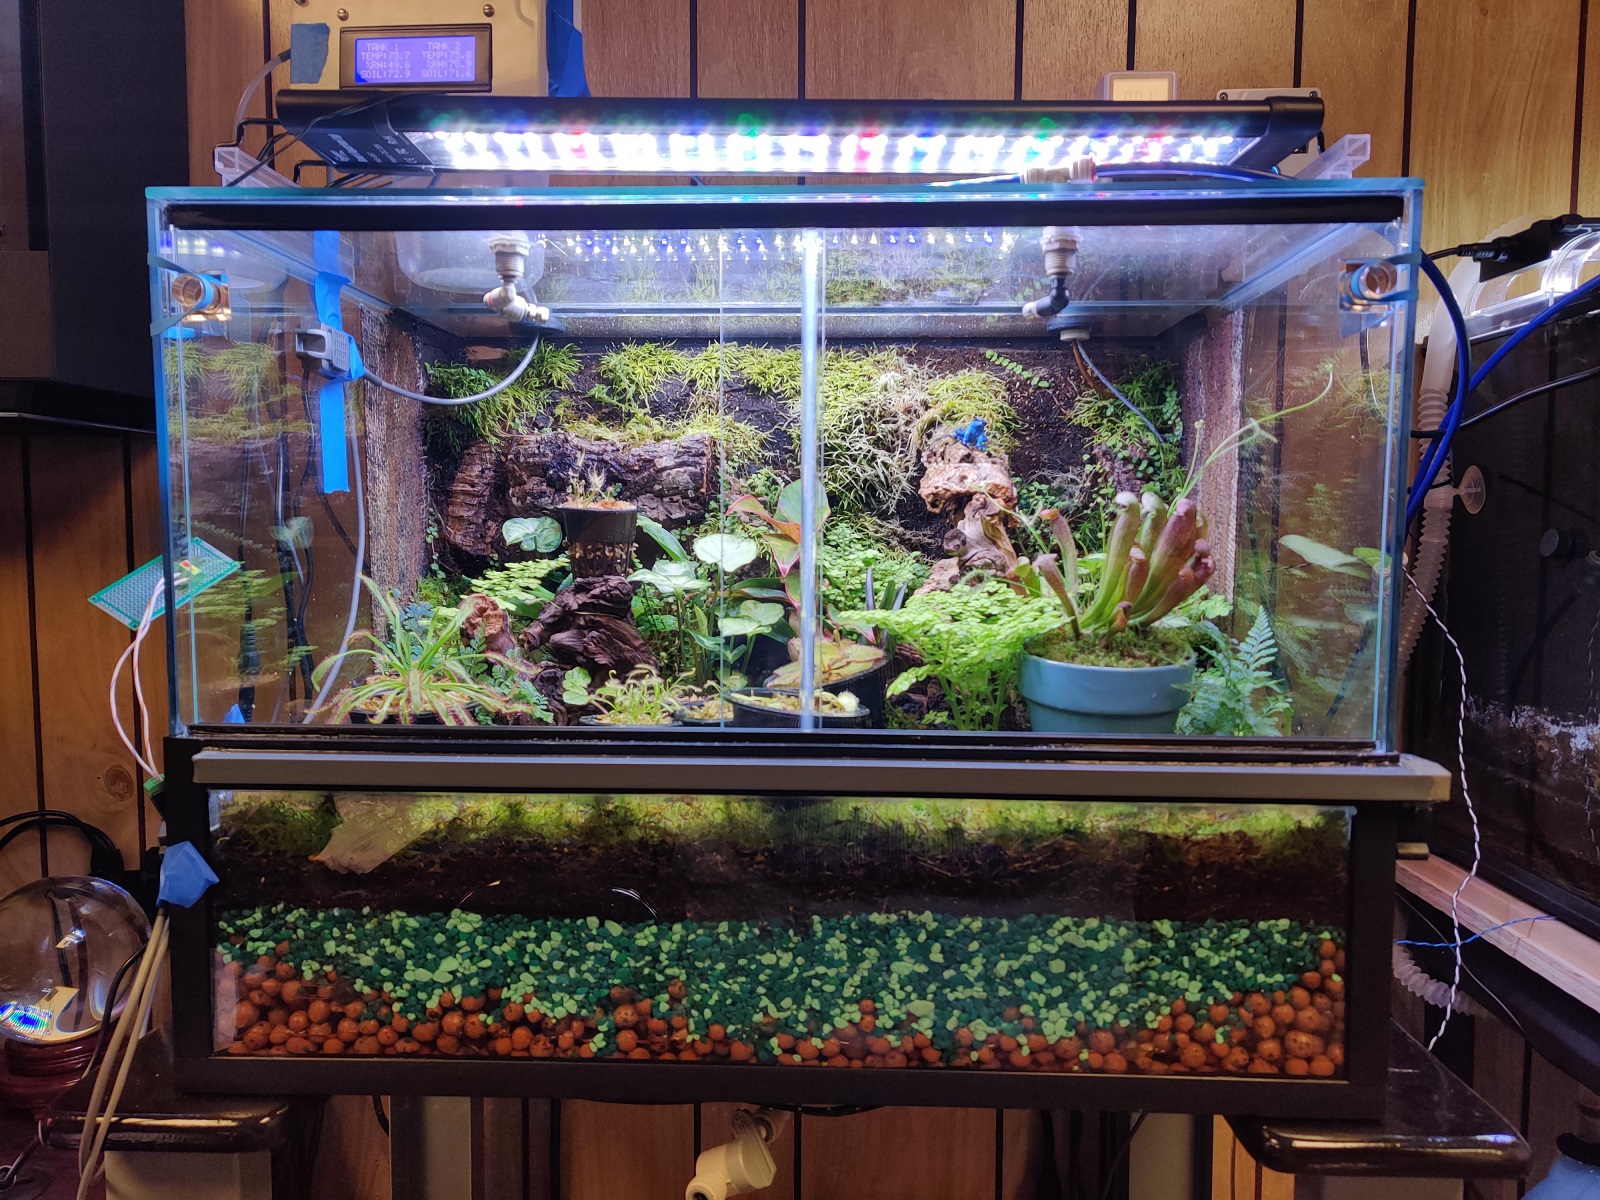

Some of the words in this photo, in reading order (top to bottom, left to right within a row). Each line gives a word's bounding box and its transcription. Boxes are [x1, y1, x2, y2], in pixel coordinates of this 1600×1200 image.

[366, 43, 388, 51] TANK
[427, 42, 449, 50] TANK
[455, 41, 461, 50] 2
[361, 51, 410, 60] TEMP:73.7
[361, 70, 410, 79] SOIL:72.9
